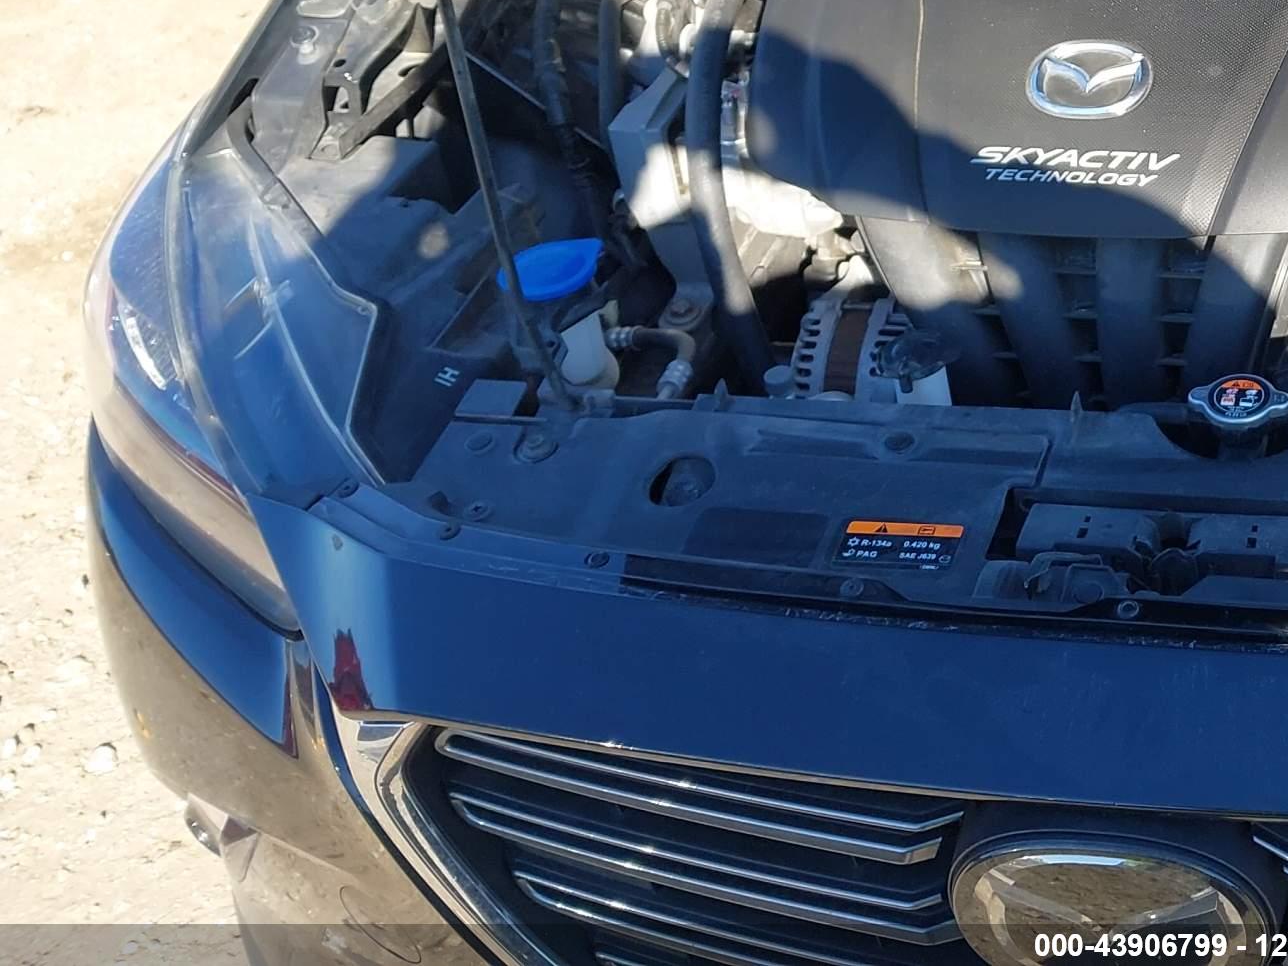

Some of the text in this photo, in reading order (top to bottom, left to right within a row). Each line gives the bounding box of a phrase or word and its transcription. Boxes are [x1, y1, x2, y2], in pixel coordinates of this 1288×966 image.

[970, 146, 1181, 171] SKYACTIV
[985, 168, 1158, 187] TECHNOLOGY
[861, 538, 941, 550] R-134a 0.420 kg
[856, 550, 878, 558] PAG
